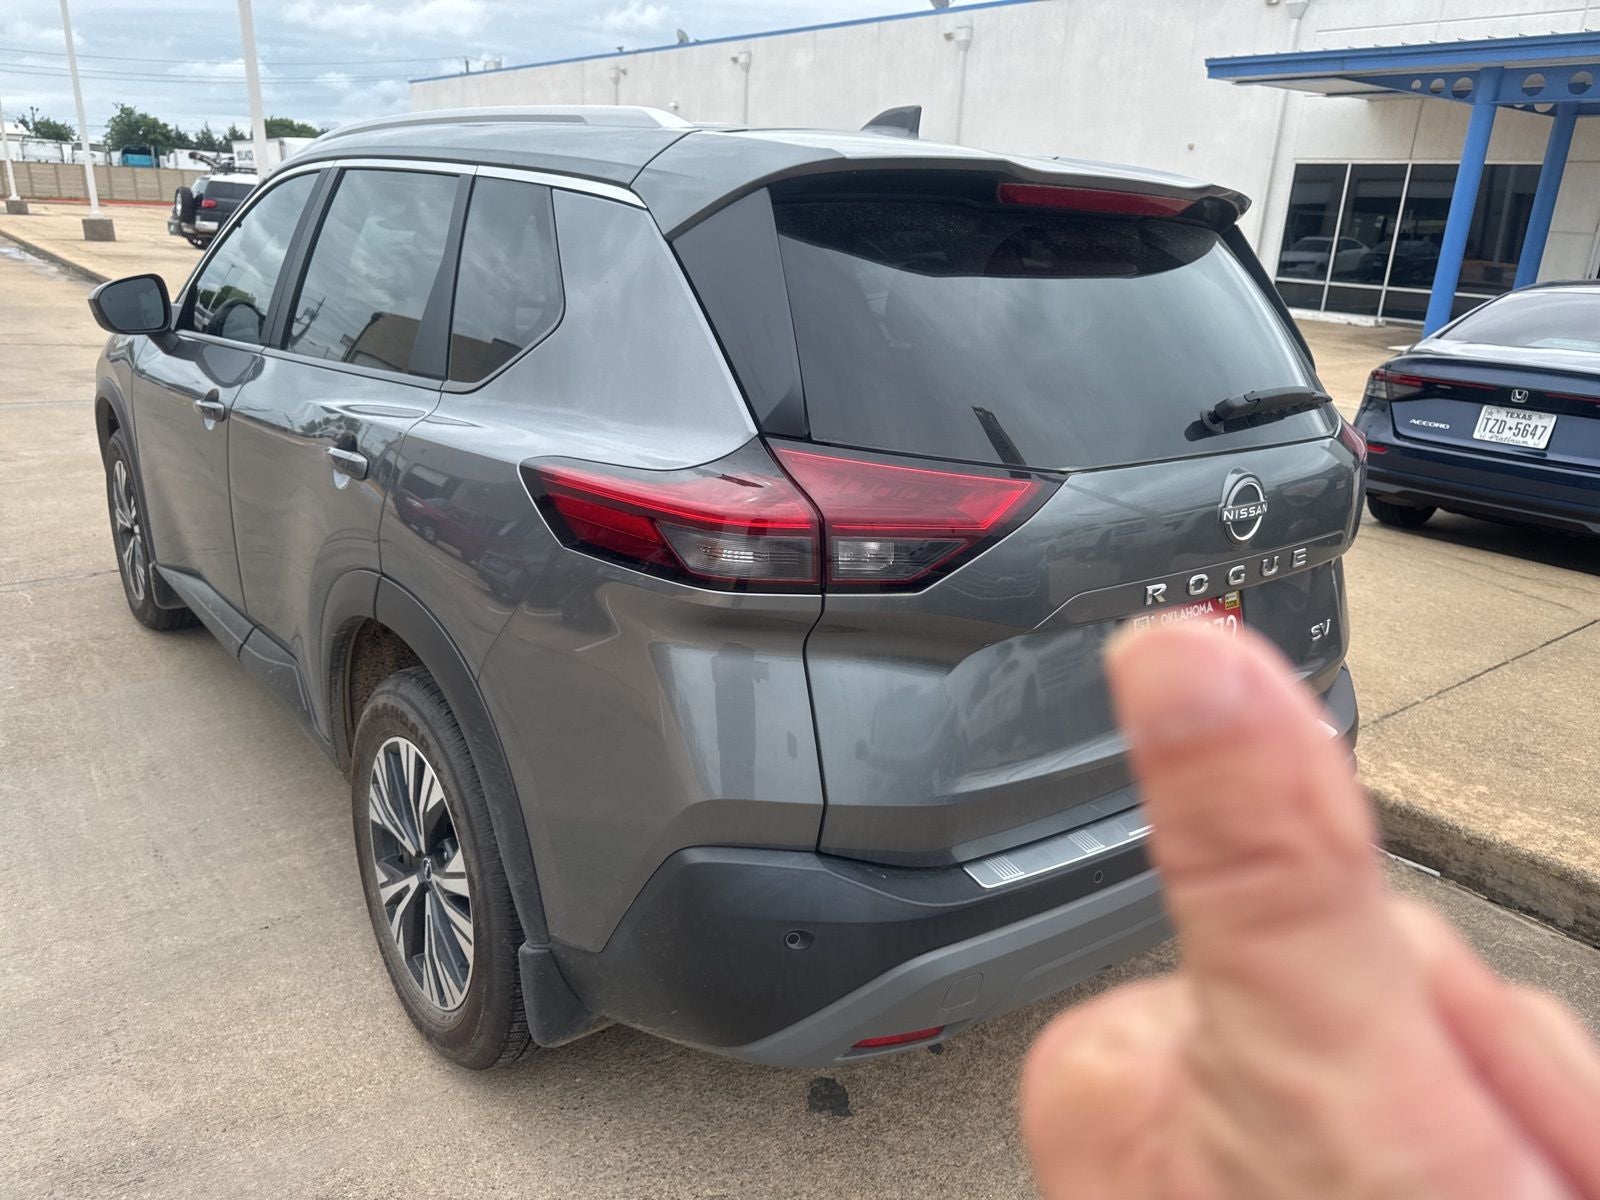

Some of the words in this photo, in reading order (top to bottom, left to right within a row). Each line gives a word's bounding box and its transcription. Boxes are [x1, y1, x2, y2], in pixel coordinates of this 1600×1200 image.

[1409, 418, 1450, 430] ACCORD
[1505, 411, 1534, 421] TEXAS
[1223, 501, 1268, 521] NISSAN
[1144, 548, 1307, 606] ROGUE
[1160, 601, 1214, 626] OKLAHOMA
[1310, 618, 1332, 642] SV
